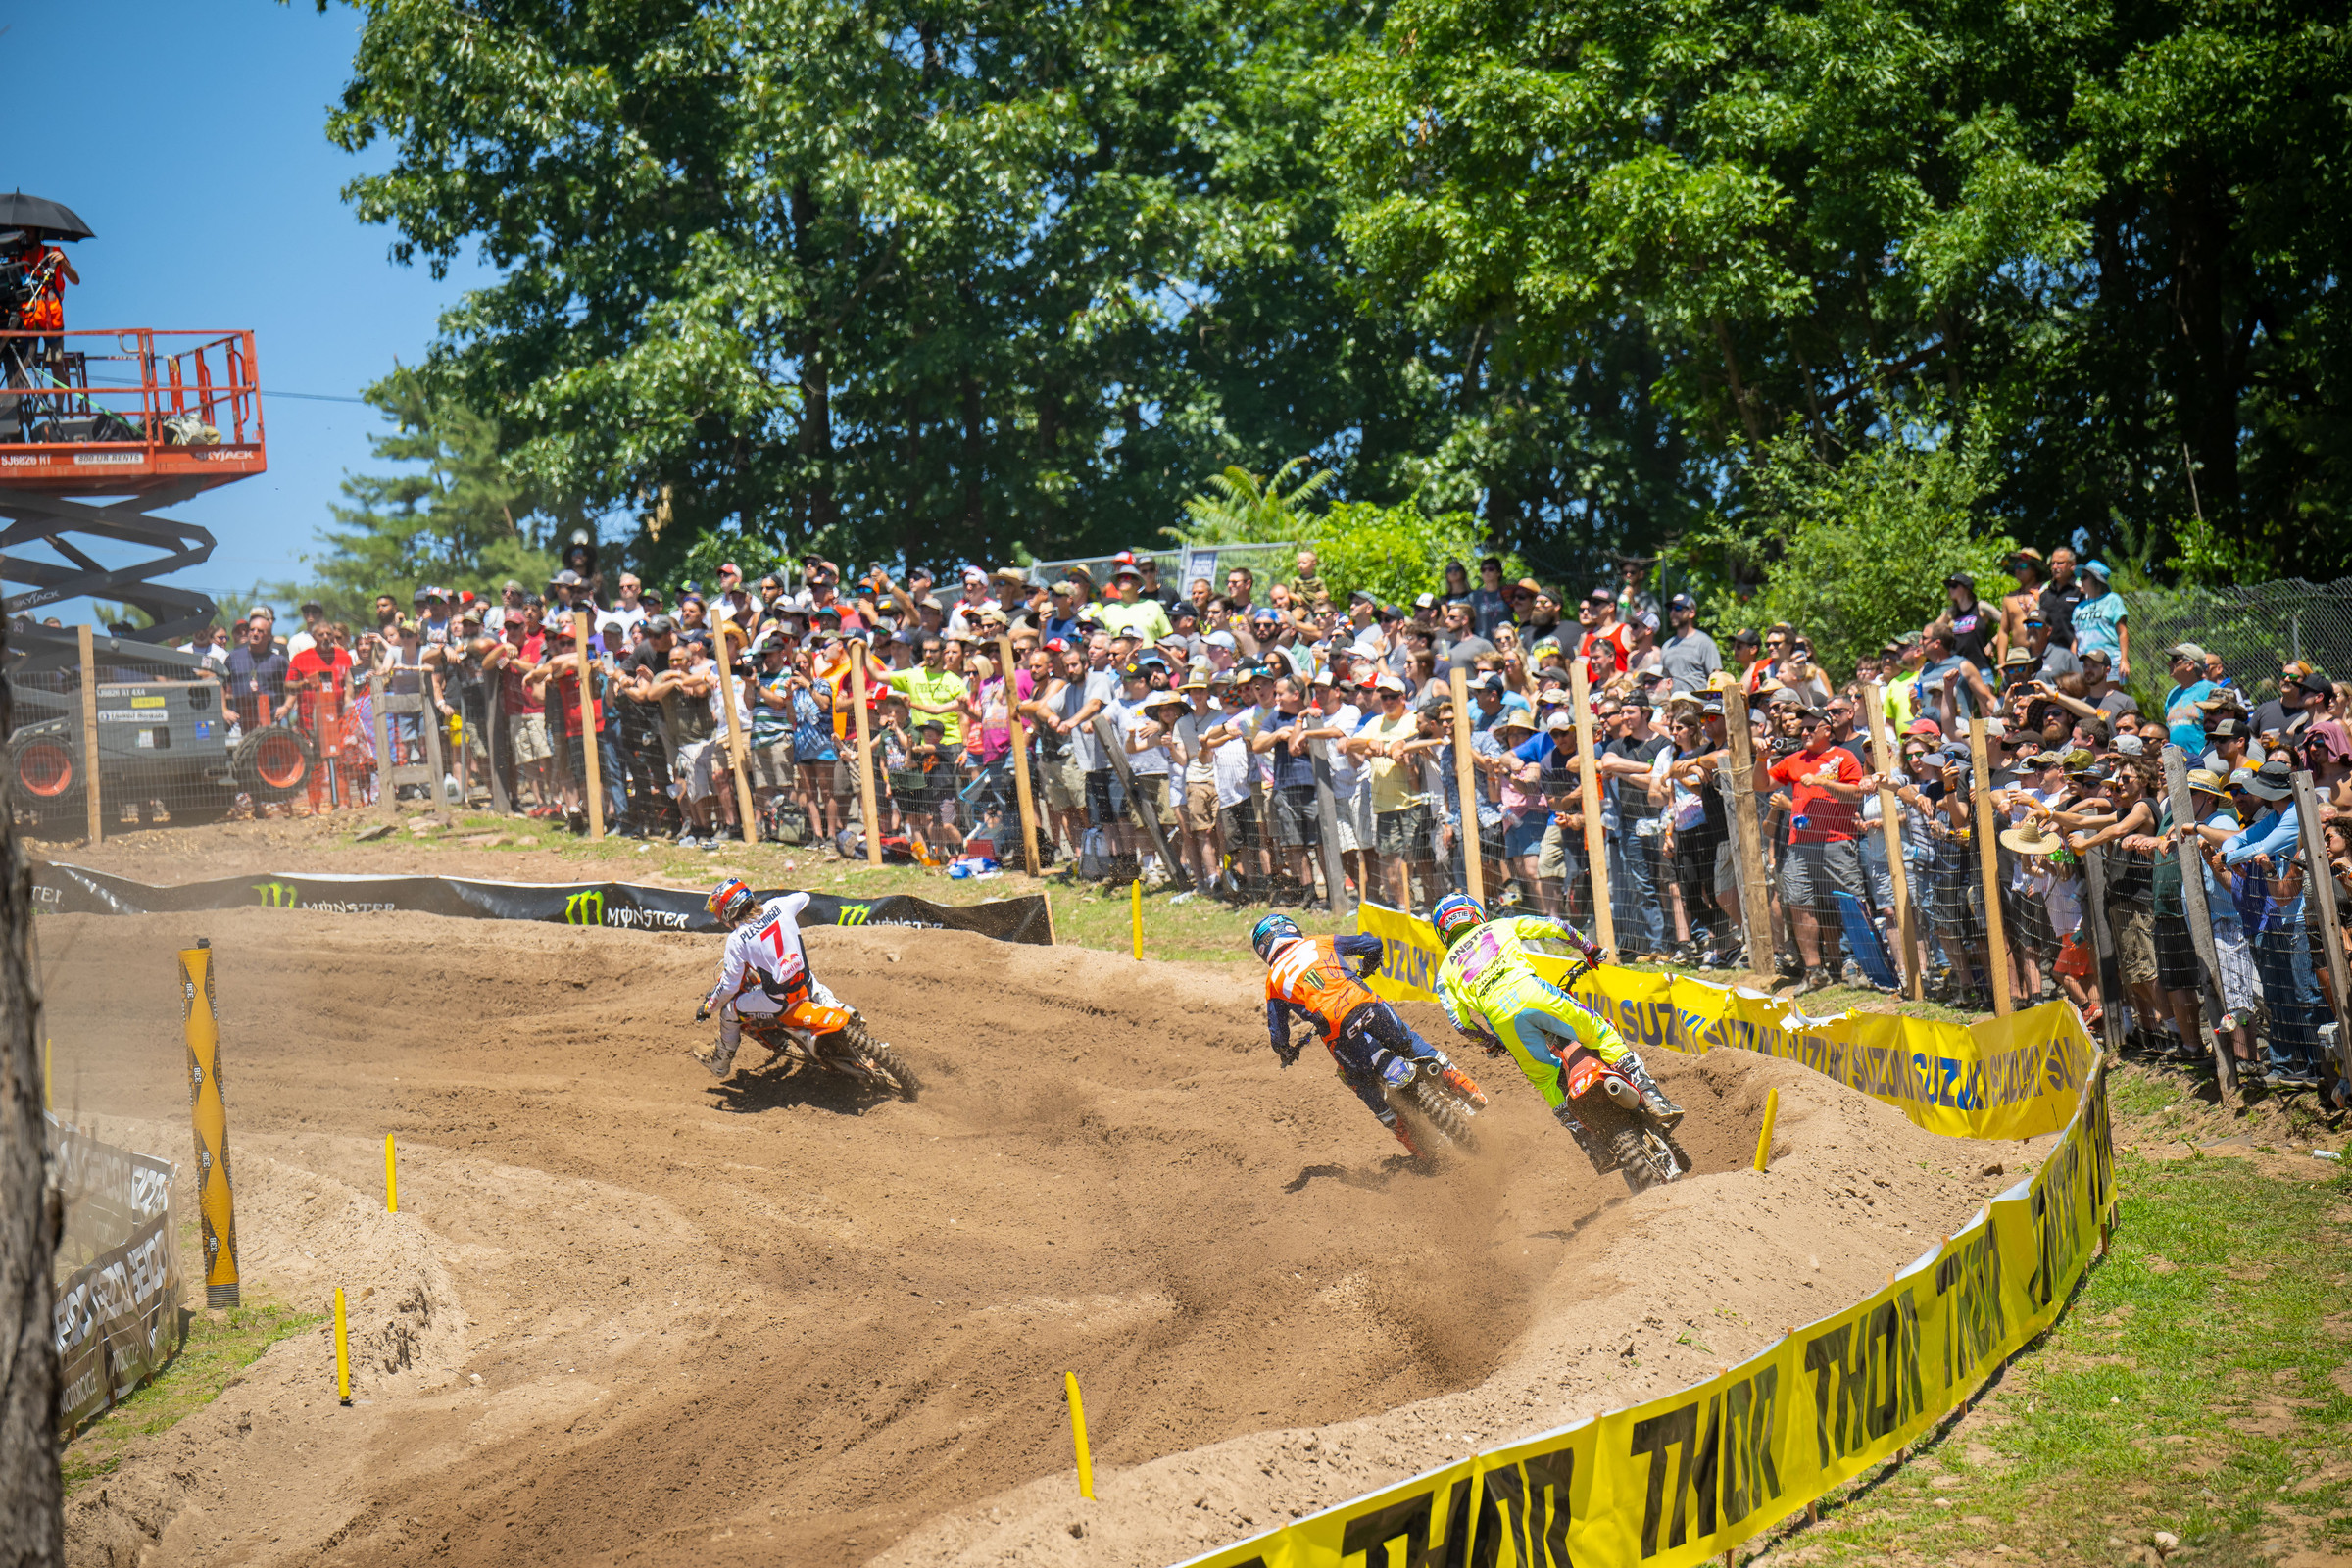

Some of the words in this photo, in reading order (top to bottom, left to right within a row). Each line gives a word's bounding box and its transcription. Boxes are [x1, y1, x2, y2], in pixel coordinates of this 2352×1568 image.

[196, 448, 254, 462] SKYJACK
[607, 906, 689, 929] MONSTER
[740, 905, 782, 944] PLESSINGER
[1446, 910, 1468, 926] ANSTIE
[760, 920, 784, 960] 7
[1449, 925, 1493, 966] ANSTIE
[782, 962, 796, 977] Red
[1358, 936, 1438, 994] UZUKI
[1497, 988, 1522, 1014] FLY
[1852, 1043, 1914, 1101] SUZUKI
[1913, 1053, 1988, 1111] SUZUKI
[202, 1152, 211, 1168] 338
[210, 1236, 219, 1253] 338
[1631, 1363, 1782, 1560] THOR
[1805, 1286, 1924, 1470] THOR
